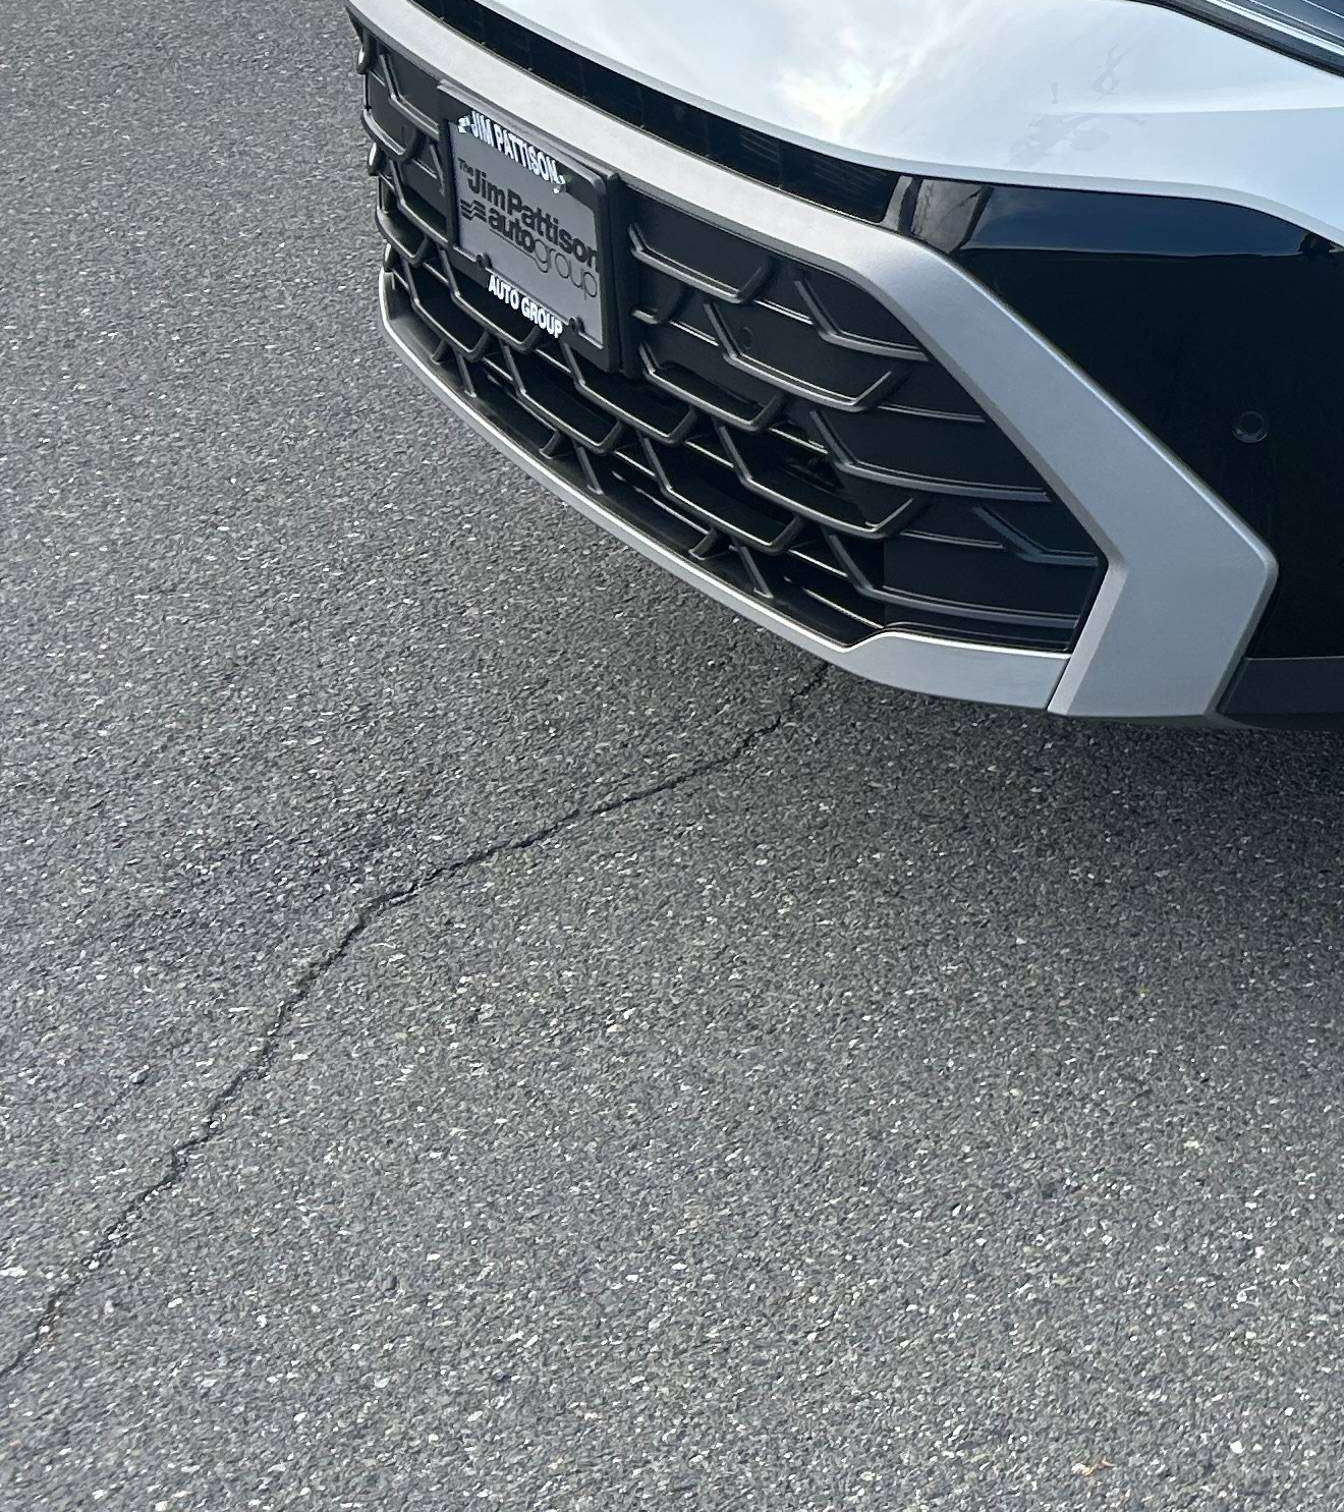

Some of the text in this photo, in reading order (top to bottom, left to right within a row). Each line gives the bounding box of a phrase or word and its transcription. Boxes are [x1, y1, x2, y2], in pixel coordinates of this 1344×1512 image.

[471, 110, 560, 185] JIM PATTISON
[488, 275, 563, 339] AUTO GROUP
